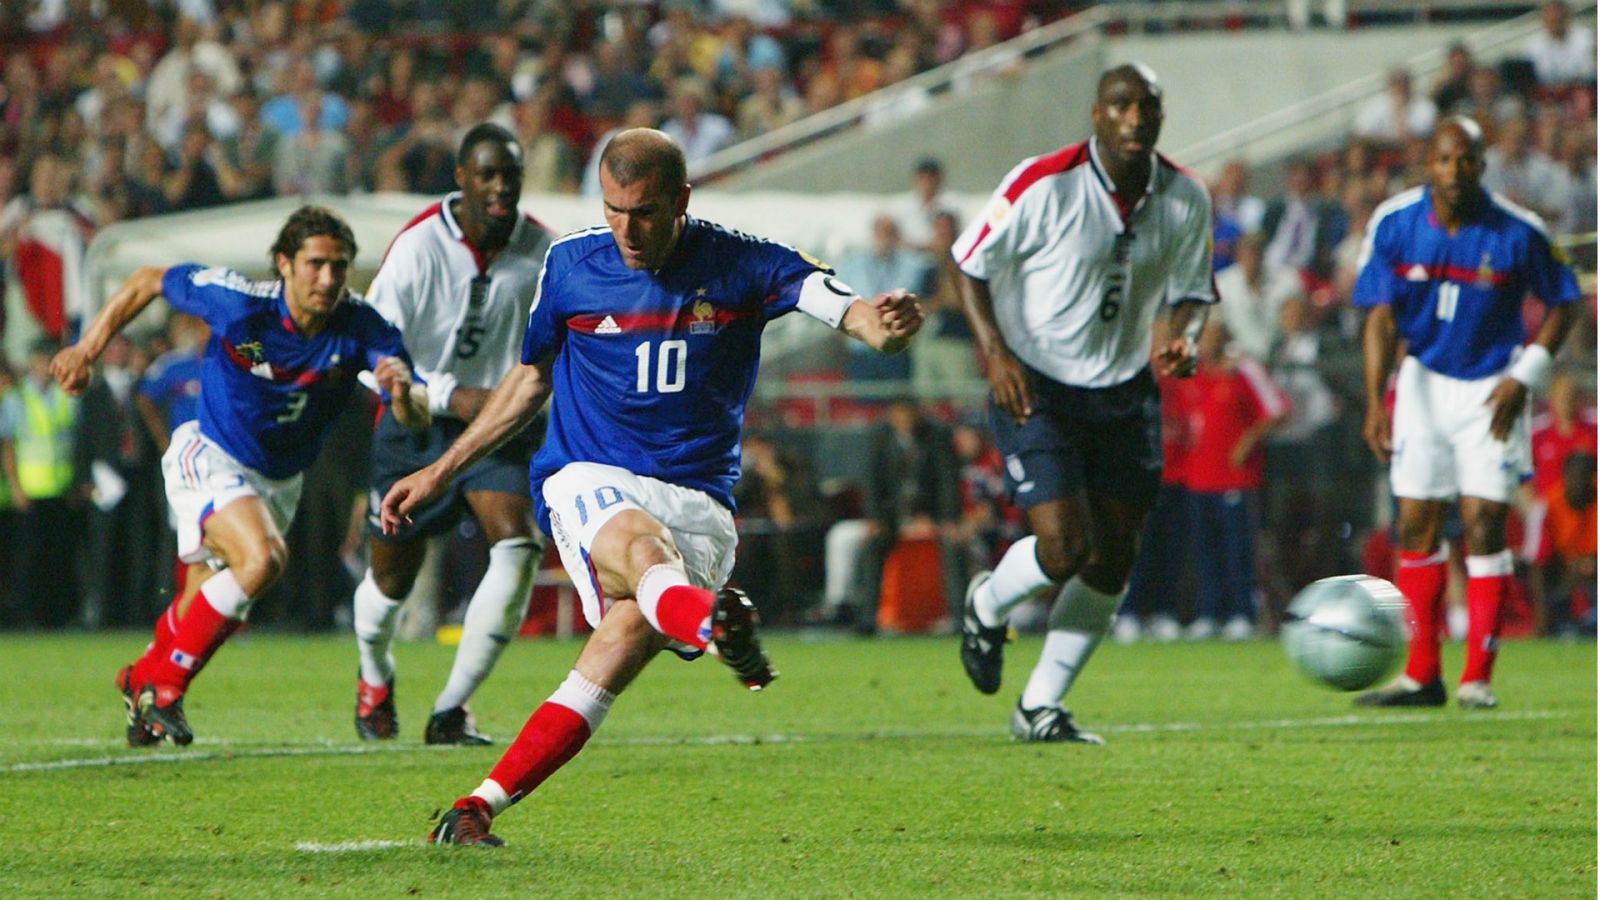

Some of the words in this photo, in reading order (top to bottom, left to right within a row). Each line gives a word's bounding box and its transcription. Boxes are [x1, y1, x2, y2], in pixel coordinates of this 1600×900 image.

[1101, 286, 1122, 321] 6
[1436, 281, 1460, 323] 11
[456, 327, 486, 359] 5
[635, 339, 687, 393] 10
[277, 391, 308, 423] 3
[575, 487, 624, 526] 10
